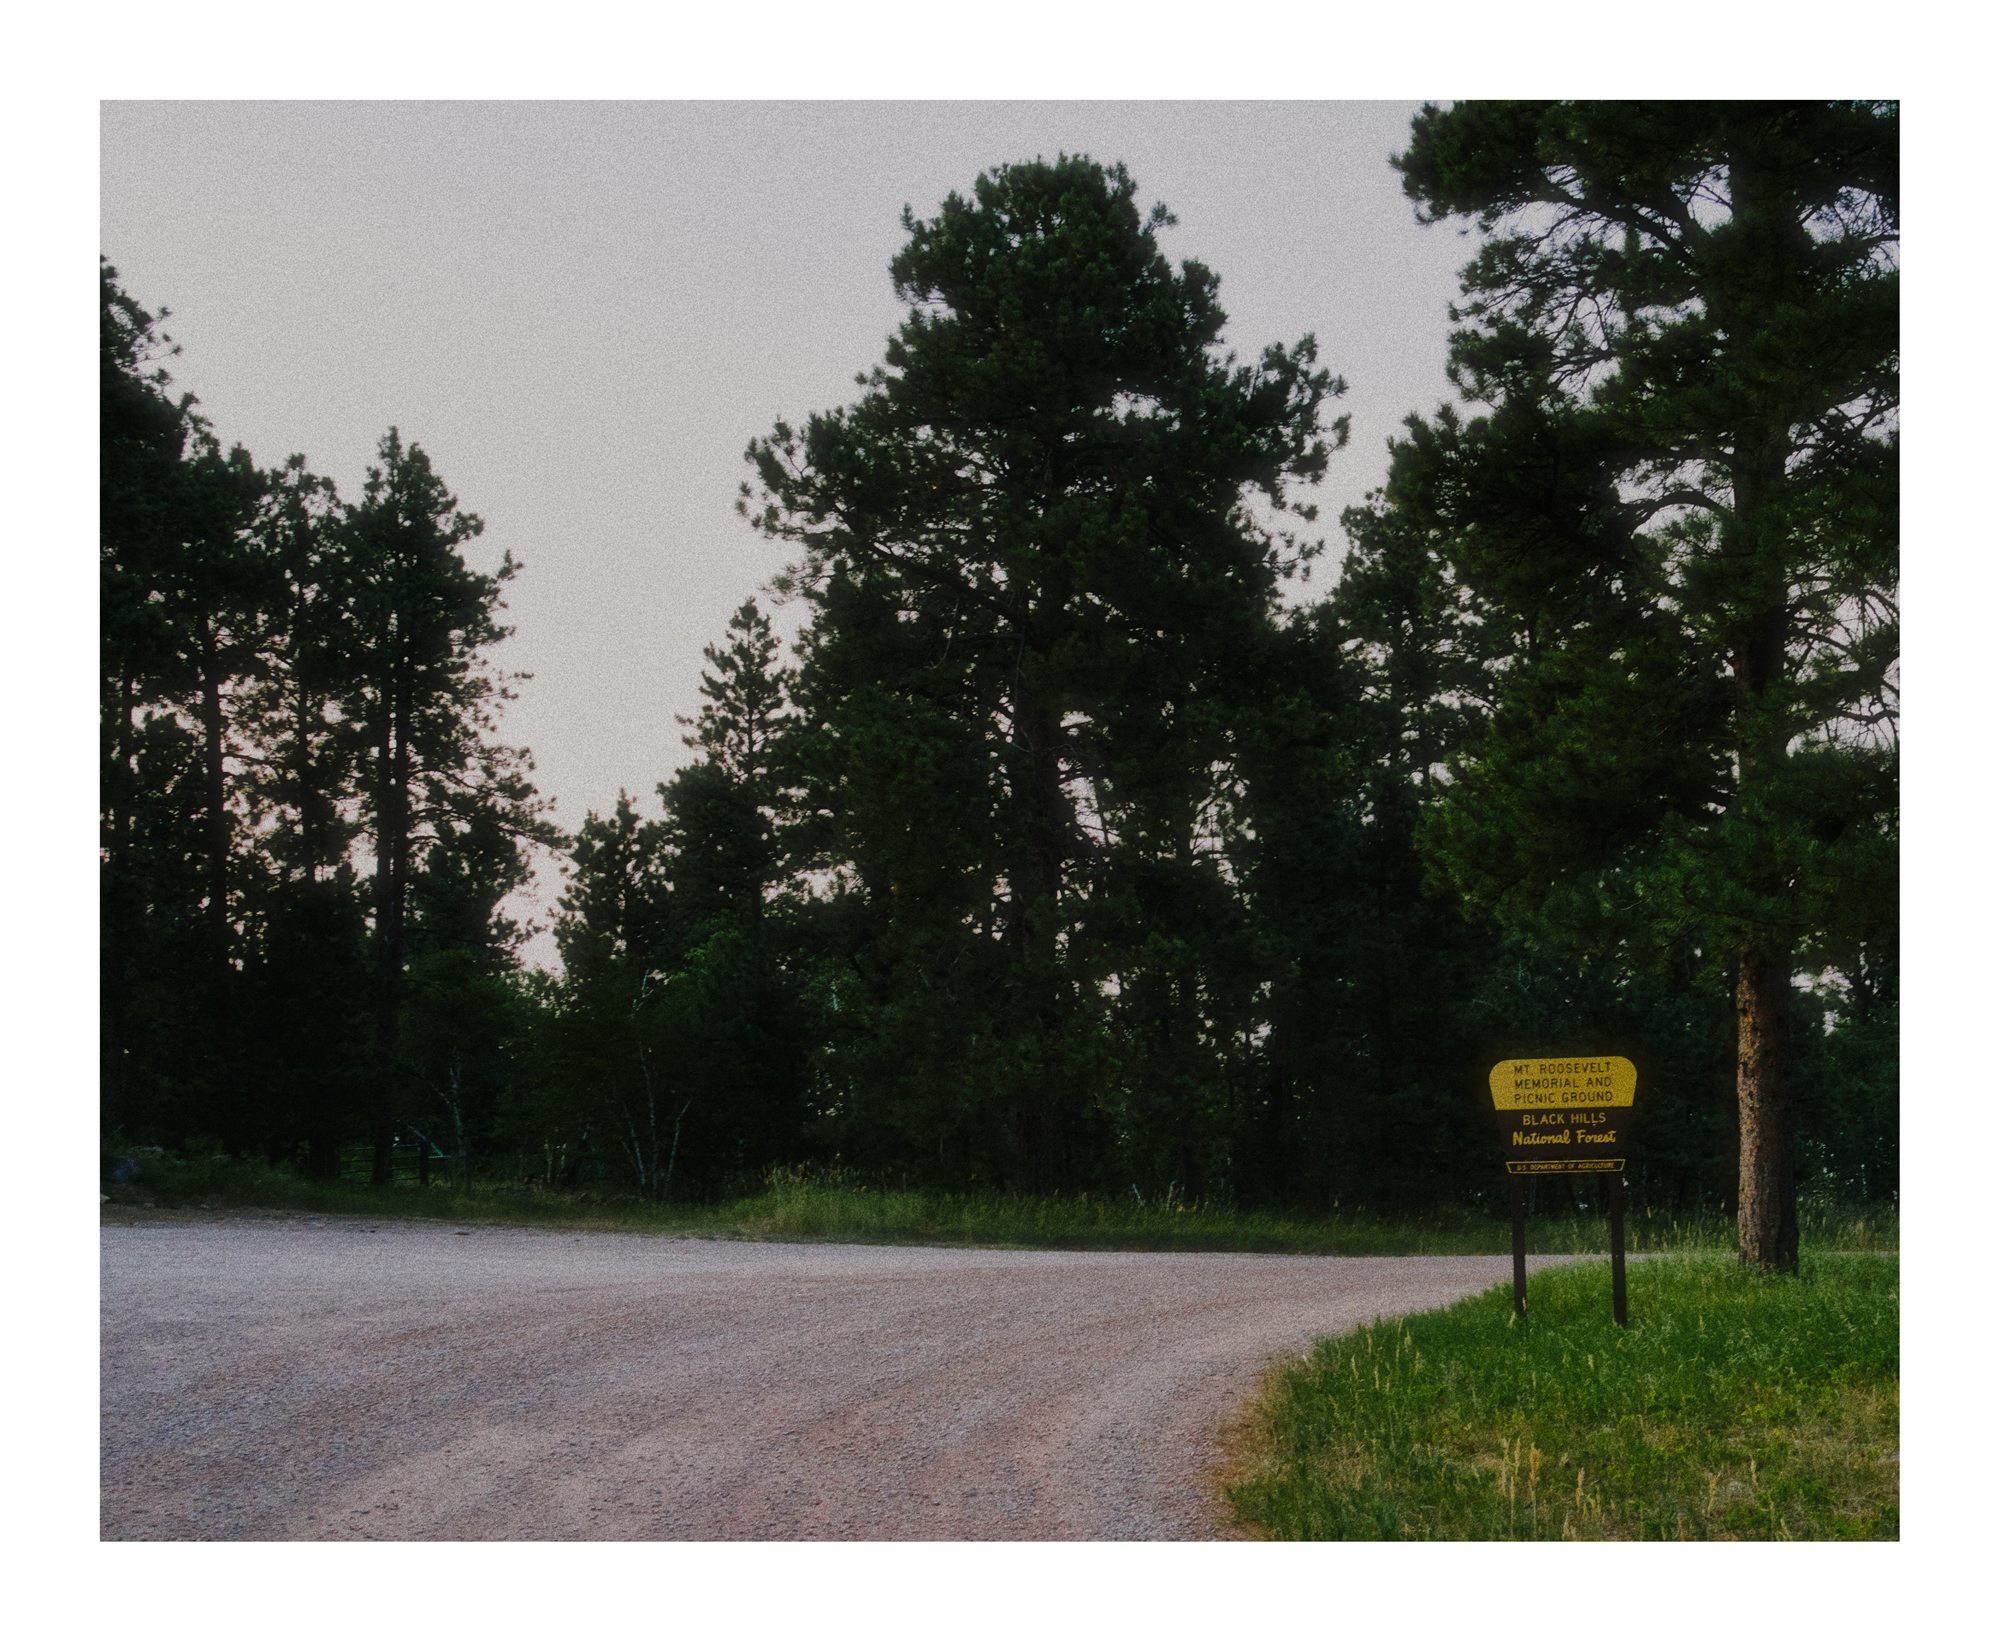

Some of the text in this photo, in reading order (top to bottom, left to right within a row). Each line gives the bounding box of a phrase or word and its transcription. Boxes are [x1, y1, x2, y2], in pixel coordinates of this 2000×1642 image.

[1514, 1062, 1611, 1076] MT. ROOSEVELT
[1514, 1076, 1612, 1089] MEMORIAL AND
[1514, 1091, 1613, 1104] PICNIC GROUND
[1522, 1112, 1607, 1126] BLACK HILLS
[1512, 1129, 1617, 1146] National Forest
